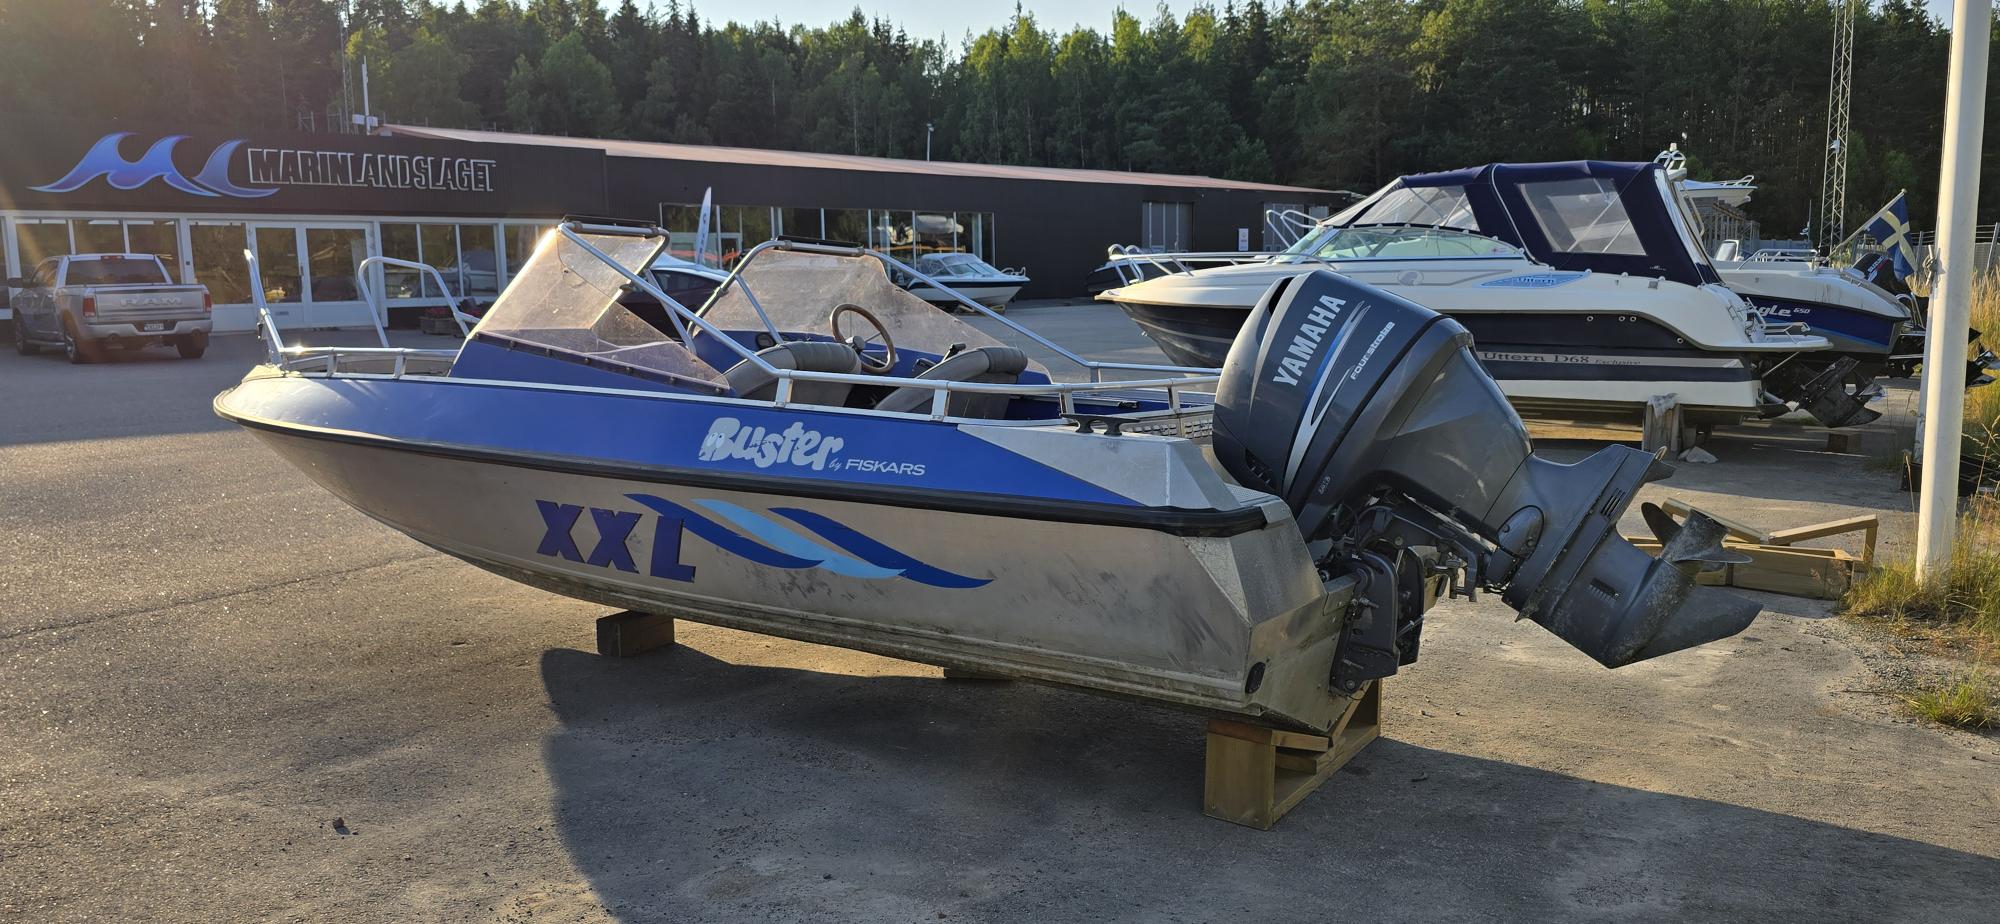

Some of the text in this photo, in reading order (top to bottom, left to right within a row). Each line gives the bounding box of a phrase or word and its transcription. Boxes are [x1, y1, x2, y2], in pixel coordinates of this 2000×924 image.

[247, 148, 497, 192] MARINLANDSLAGET
[120, 297, 183, 307] RAM
[1273, 295, 1346, 386] YAMAHA
[1484, 352, 1545, 361] Uttern
[1554, 355, 1590, 363] D68
[699, 417, 926, 476] Buster by FISKARS
[535, 499, 697, 584] XXL
